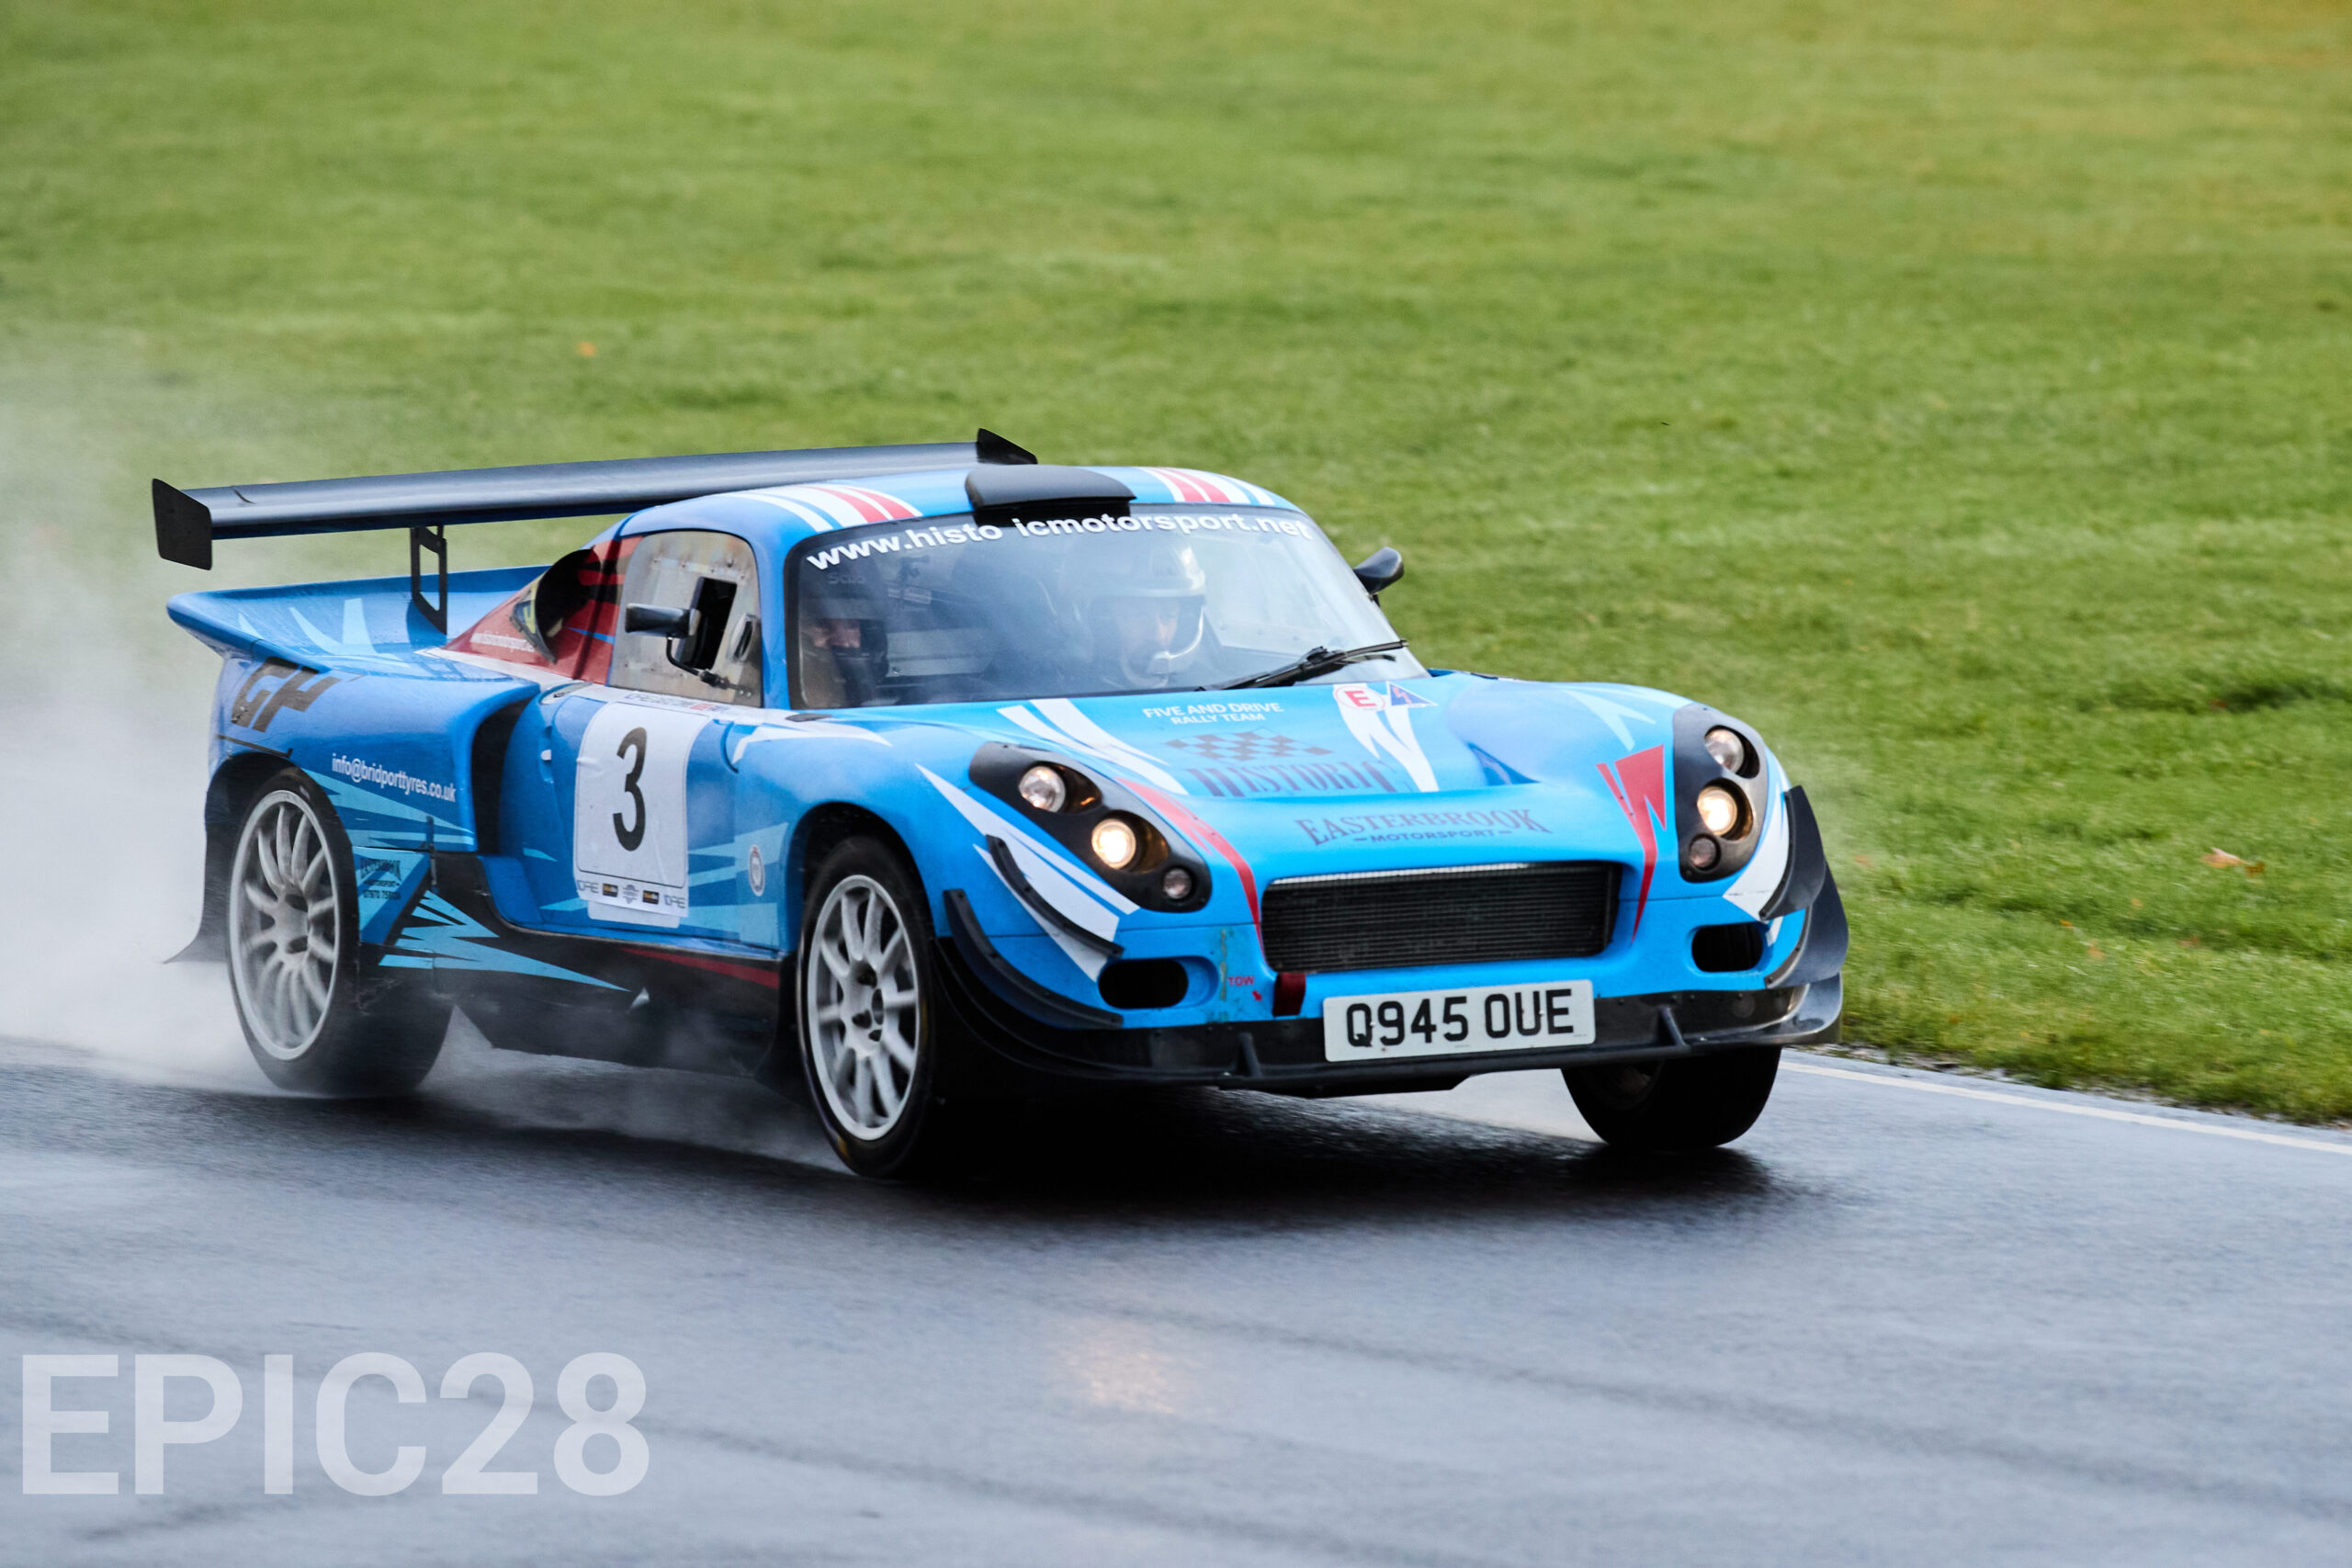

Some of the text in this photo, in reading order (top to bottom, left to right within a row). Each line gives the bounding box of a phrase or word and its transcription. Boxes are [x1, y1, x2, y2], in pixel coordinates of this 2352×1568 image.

[1344, 691, 1376, 707] E
[1142, 702, 1284, 718] FIVE AND DRIVE
[1170, 713, 1266, 725] RALLY TEAM
[332, 752, 456, 802] info@bridporttyres.co.uk
[613, 727, 647, 852] 3
[1295, 808, 1553, 846] EASTERBROOK
[1371, 829, 1495, 842] MOTORSPORT
[1227, 976, 1254, 987] TOW
[1346, 988, 1574, 1047] Q945 OUE
